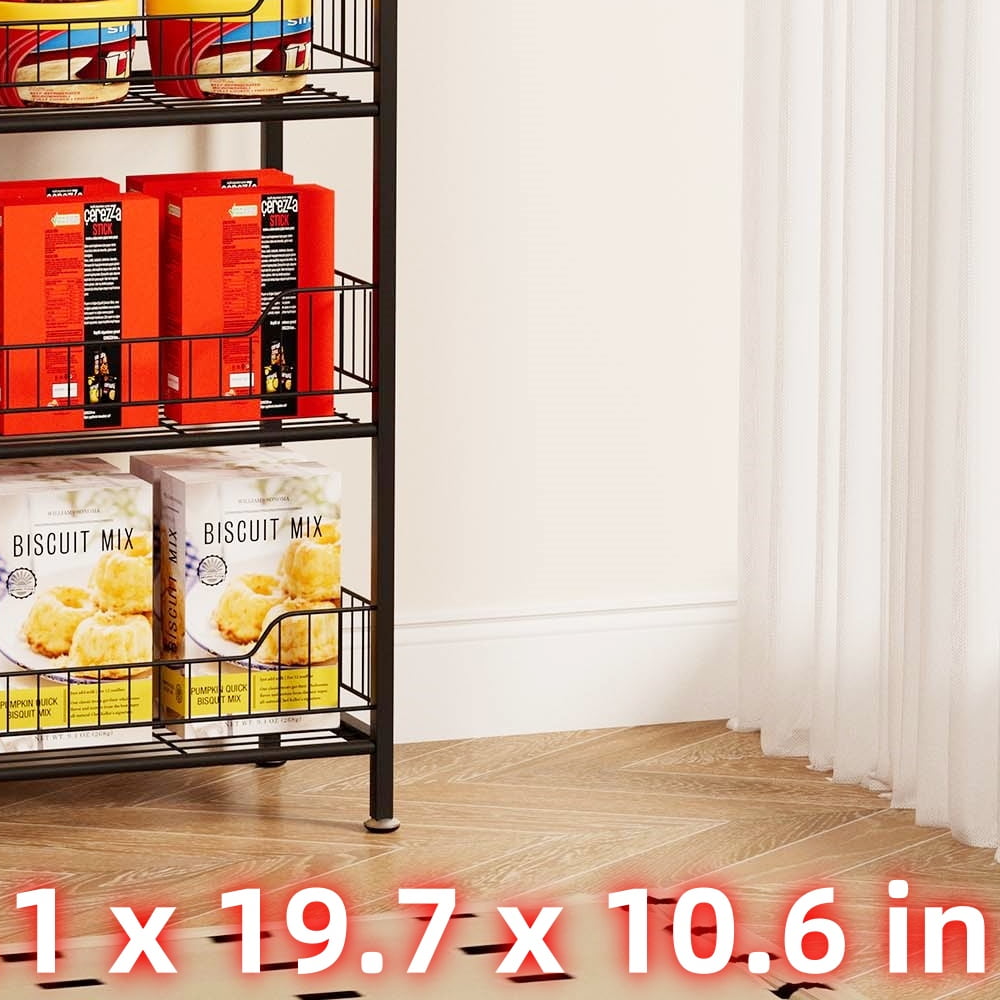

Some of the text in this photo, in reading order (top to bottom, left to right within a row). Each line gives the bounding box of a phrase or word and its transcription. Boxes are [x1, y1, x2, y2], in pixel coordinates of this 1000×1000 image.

[270, 214, 289, 226] STICK
[93, 223, 112, 235] STICK
[204, 516, 322, 544] BISCUIT MIX
[13, 528, 133, 557] BISCUIT MIX
[168, 528, 177, 564] MIX
[226, 683, 247, 693] QUICK
[227, 695, 241, 703] MIX
